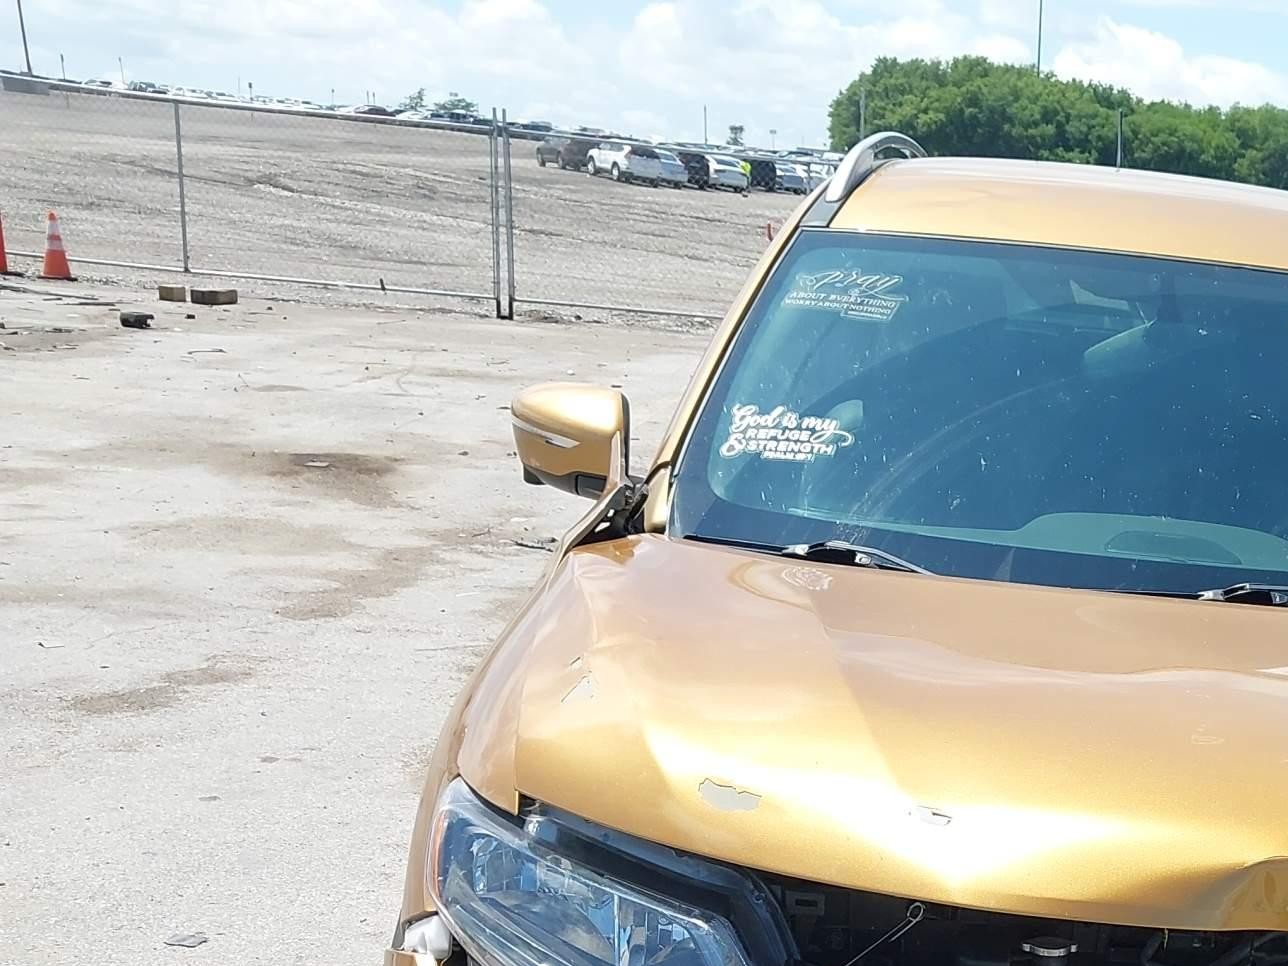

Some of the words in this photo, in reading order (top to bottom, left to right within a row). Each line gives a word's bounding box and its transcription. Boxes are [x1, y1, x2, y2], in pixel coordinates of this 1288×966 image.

[784, 299, 817, 307] WORRY
[817, 301, 849, 309] ABOUT
[848, 304, 892, 315] NOTHING
[789, 291, 828, 300] ABOUT
[828, 293, 896, 308] EVERYTHING
[732, 404, 785, 432] God
[783, 411, 798, 429] is
[745, 428, 812, 442] REFUGE
[720, 433, 746, 458] &
[746, 439, 836, 456] STRENGTH
